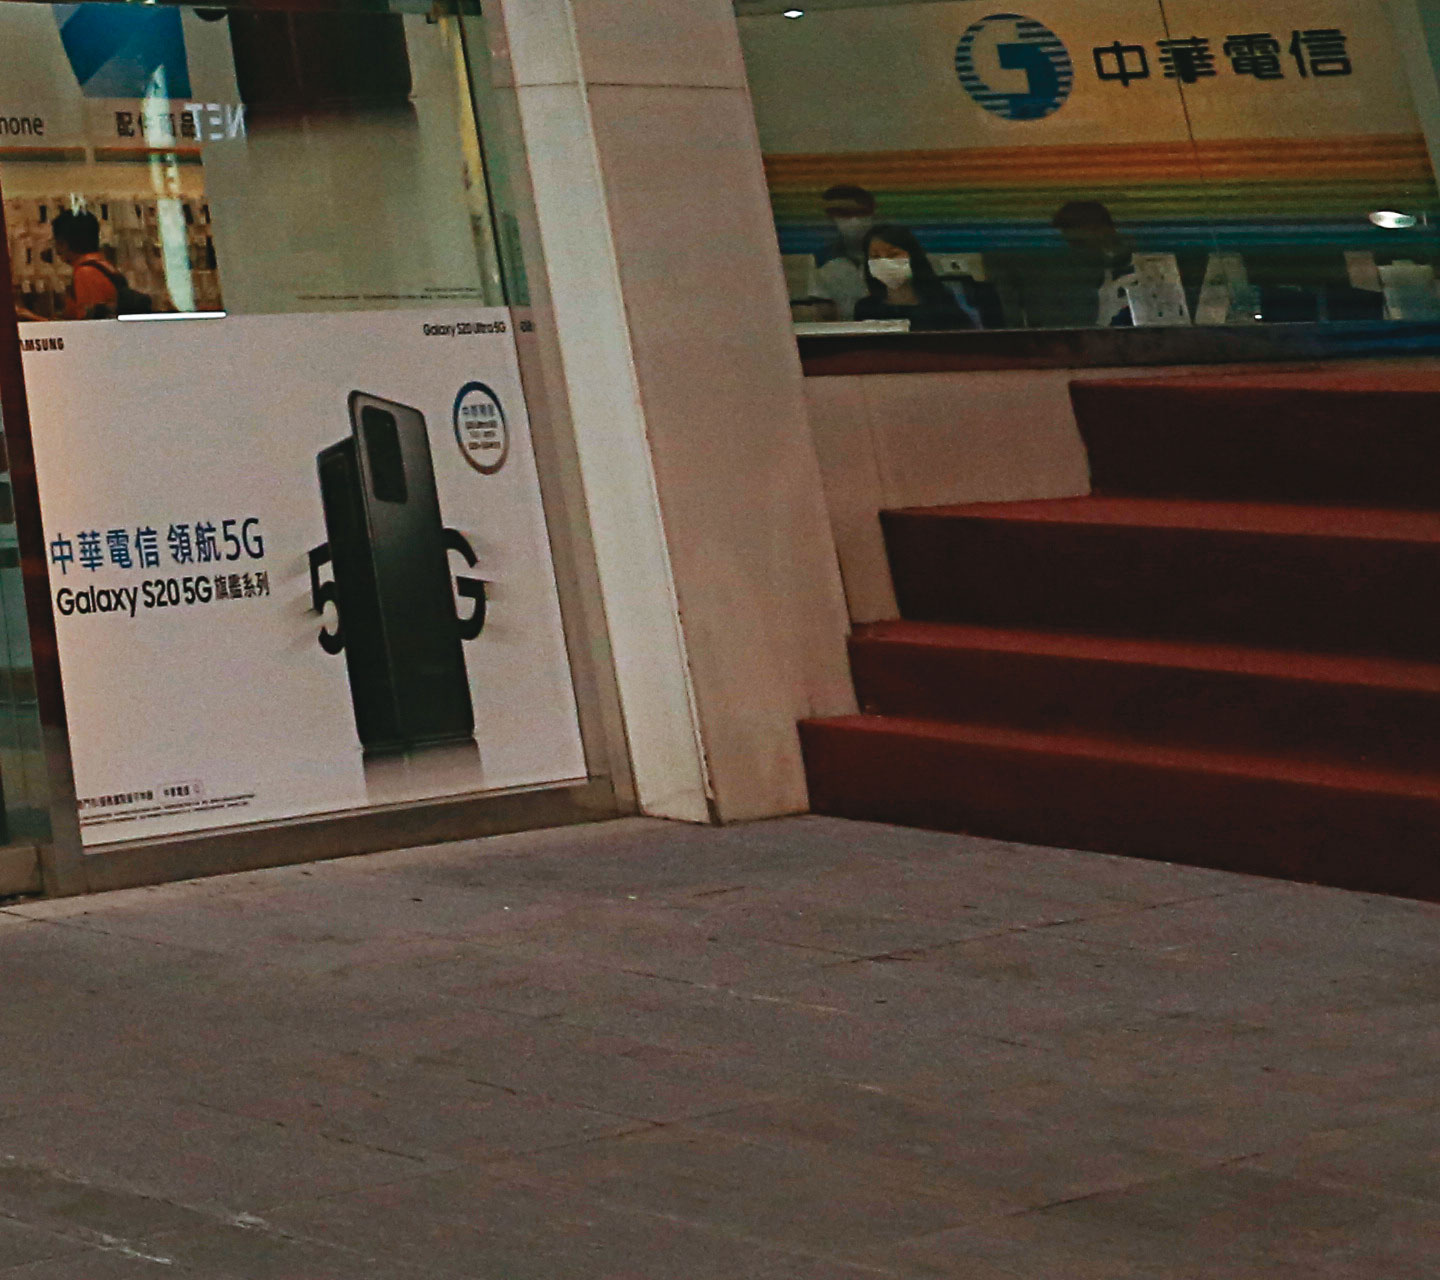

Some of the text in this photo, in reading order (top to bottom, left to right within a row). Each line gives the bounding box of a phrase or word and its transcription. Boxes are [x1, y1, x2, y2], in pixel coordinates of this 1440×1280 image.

[1092, 28, 1353, 88] 中華電信
[423, 322, 456, 337] Galaxy
[50, 517, 265, 576] 中華電信 領航5G
[56, 584, 139, 618] Galaxy
[141, 577, 181, 609] S20
